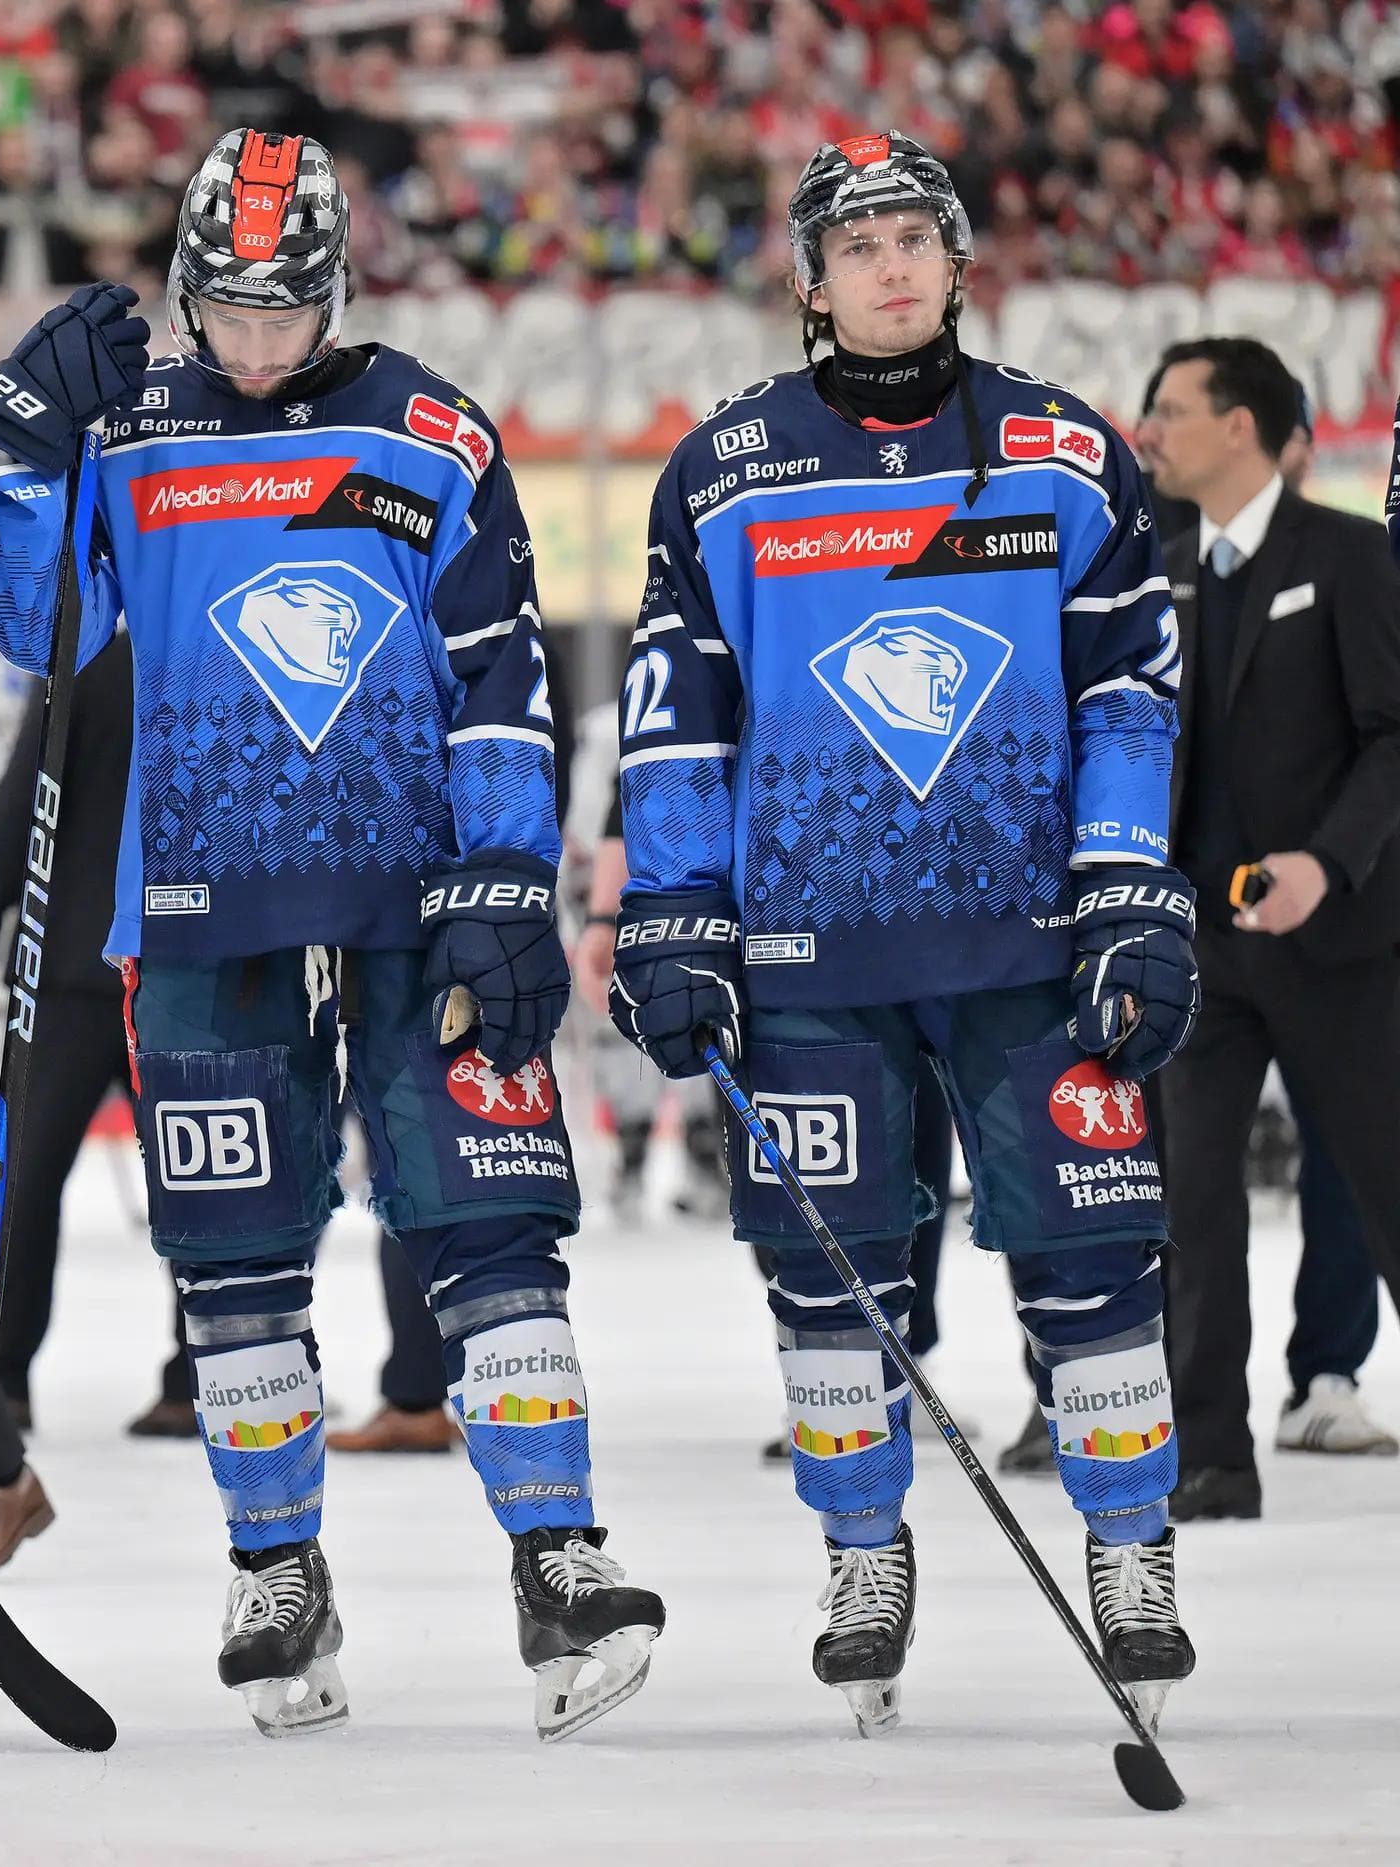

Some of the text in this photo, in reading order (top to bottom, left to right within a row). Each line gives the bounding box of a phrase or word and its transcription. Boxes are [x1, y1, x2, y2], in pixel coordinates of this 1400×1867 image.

[248, 196, 274, 211] 28
[221, 274, 278, 288] BAUER
[139, 417, 223, 442] Bayern
[718, 424, 762, 454] DB
[687, 456, 820, 517] Regio Bayern
[985, 530, 1057, 557] SATURN
[623, 648, 676, 741] 12
[1076, 822, 1121, 843] ERC
[9, 769, 61, 1044] BAUER
[420, 883, 550, 923] AUER
[166, 1114, 256, 1177] DB
[758, 1106, 842, 1171] DB
[470, 1157, 569, 1182] Hackner
[1055, 1155, 1160, 1187] Backhau
[857, 1288, 889, 1333] BAUER
[260, 1493, 323, 1522] BAUER
[508, 1483, 580, 1504] BAUER
